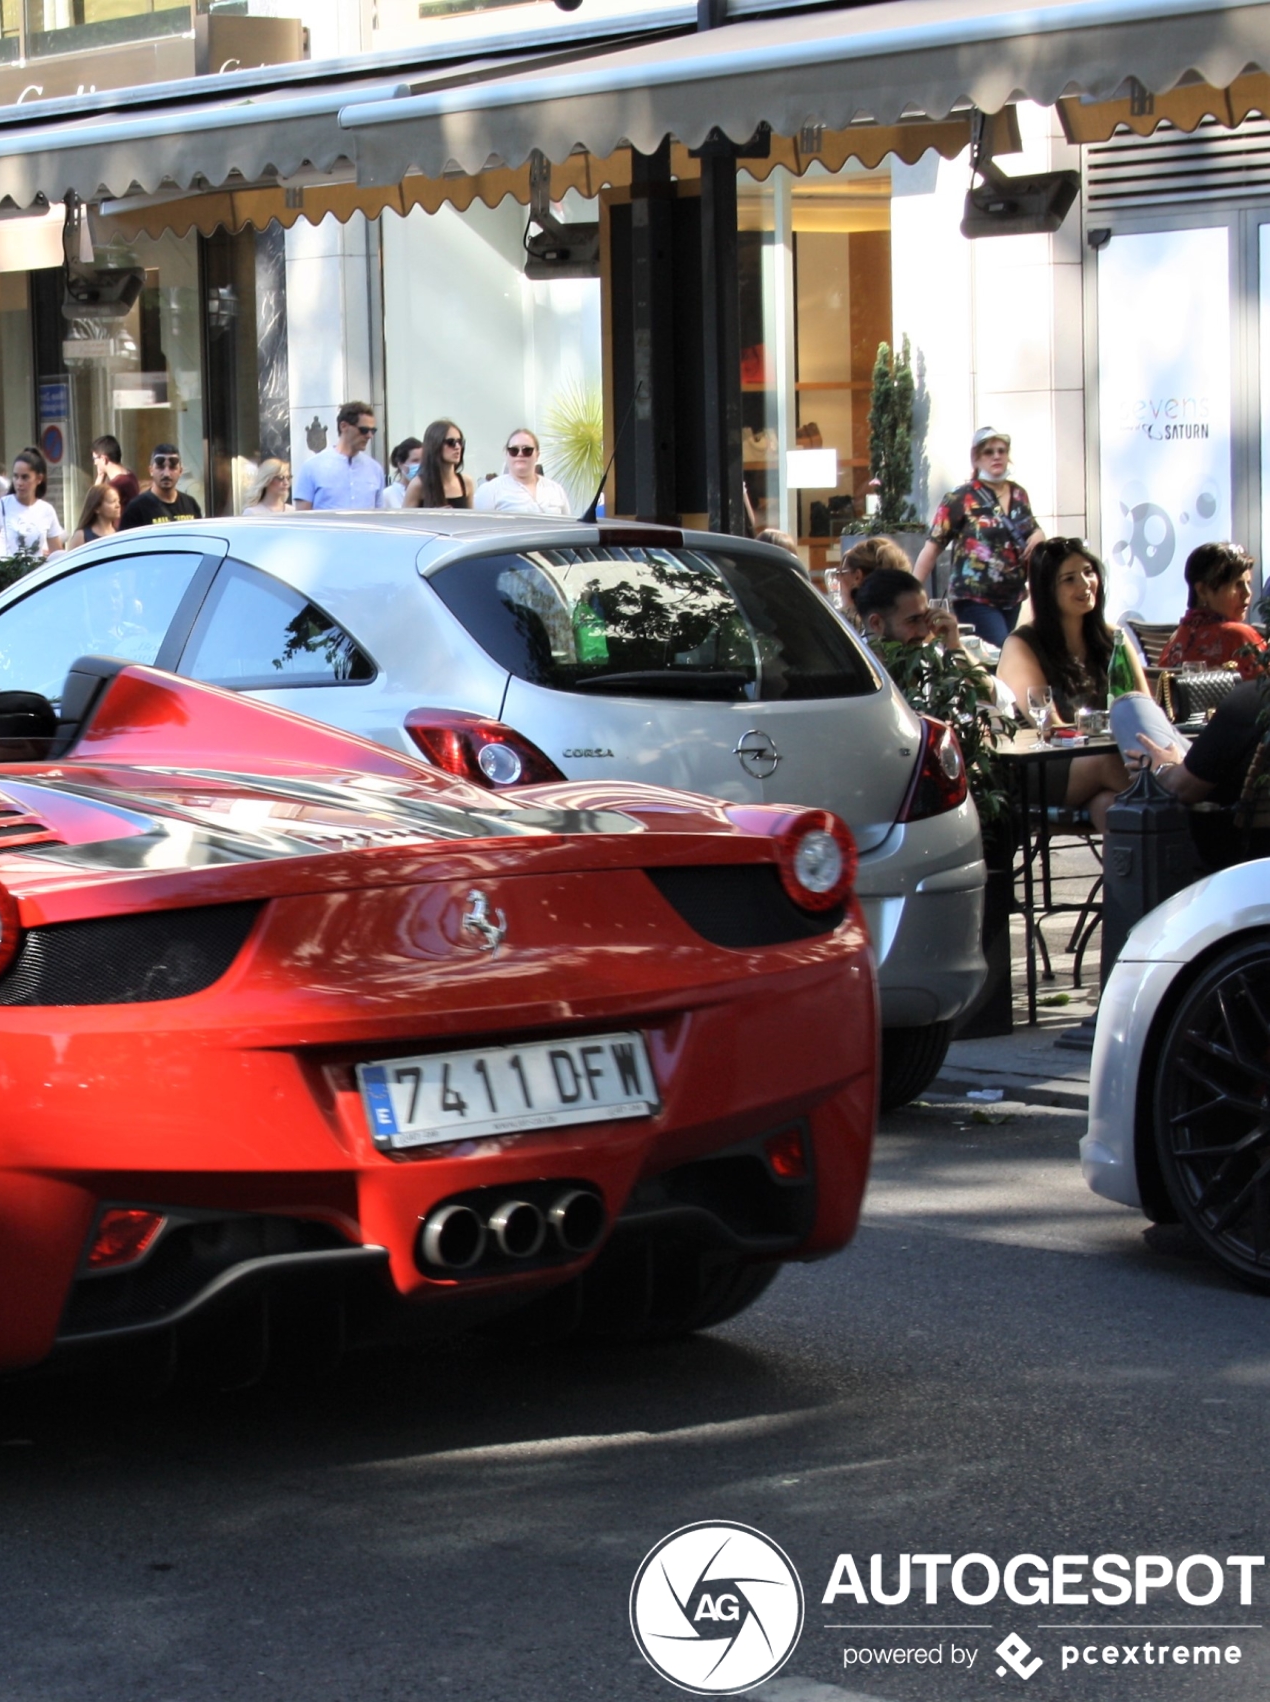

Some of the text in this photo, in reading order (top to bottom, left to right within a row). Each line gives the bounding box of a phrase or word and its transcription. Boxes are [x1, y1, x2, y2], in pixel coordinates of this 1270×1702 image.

[1120, 397, 1209, 420] sevens
[1165, 424, 1209, 440] SATURN
[562, 748, 615, 758] CORSA
[395, 1043, 643, 1124] 7411 DFW
[375, 1107, 392, 1124] E
